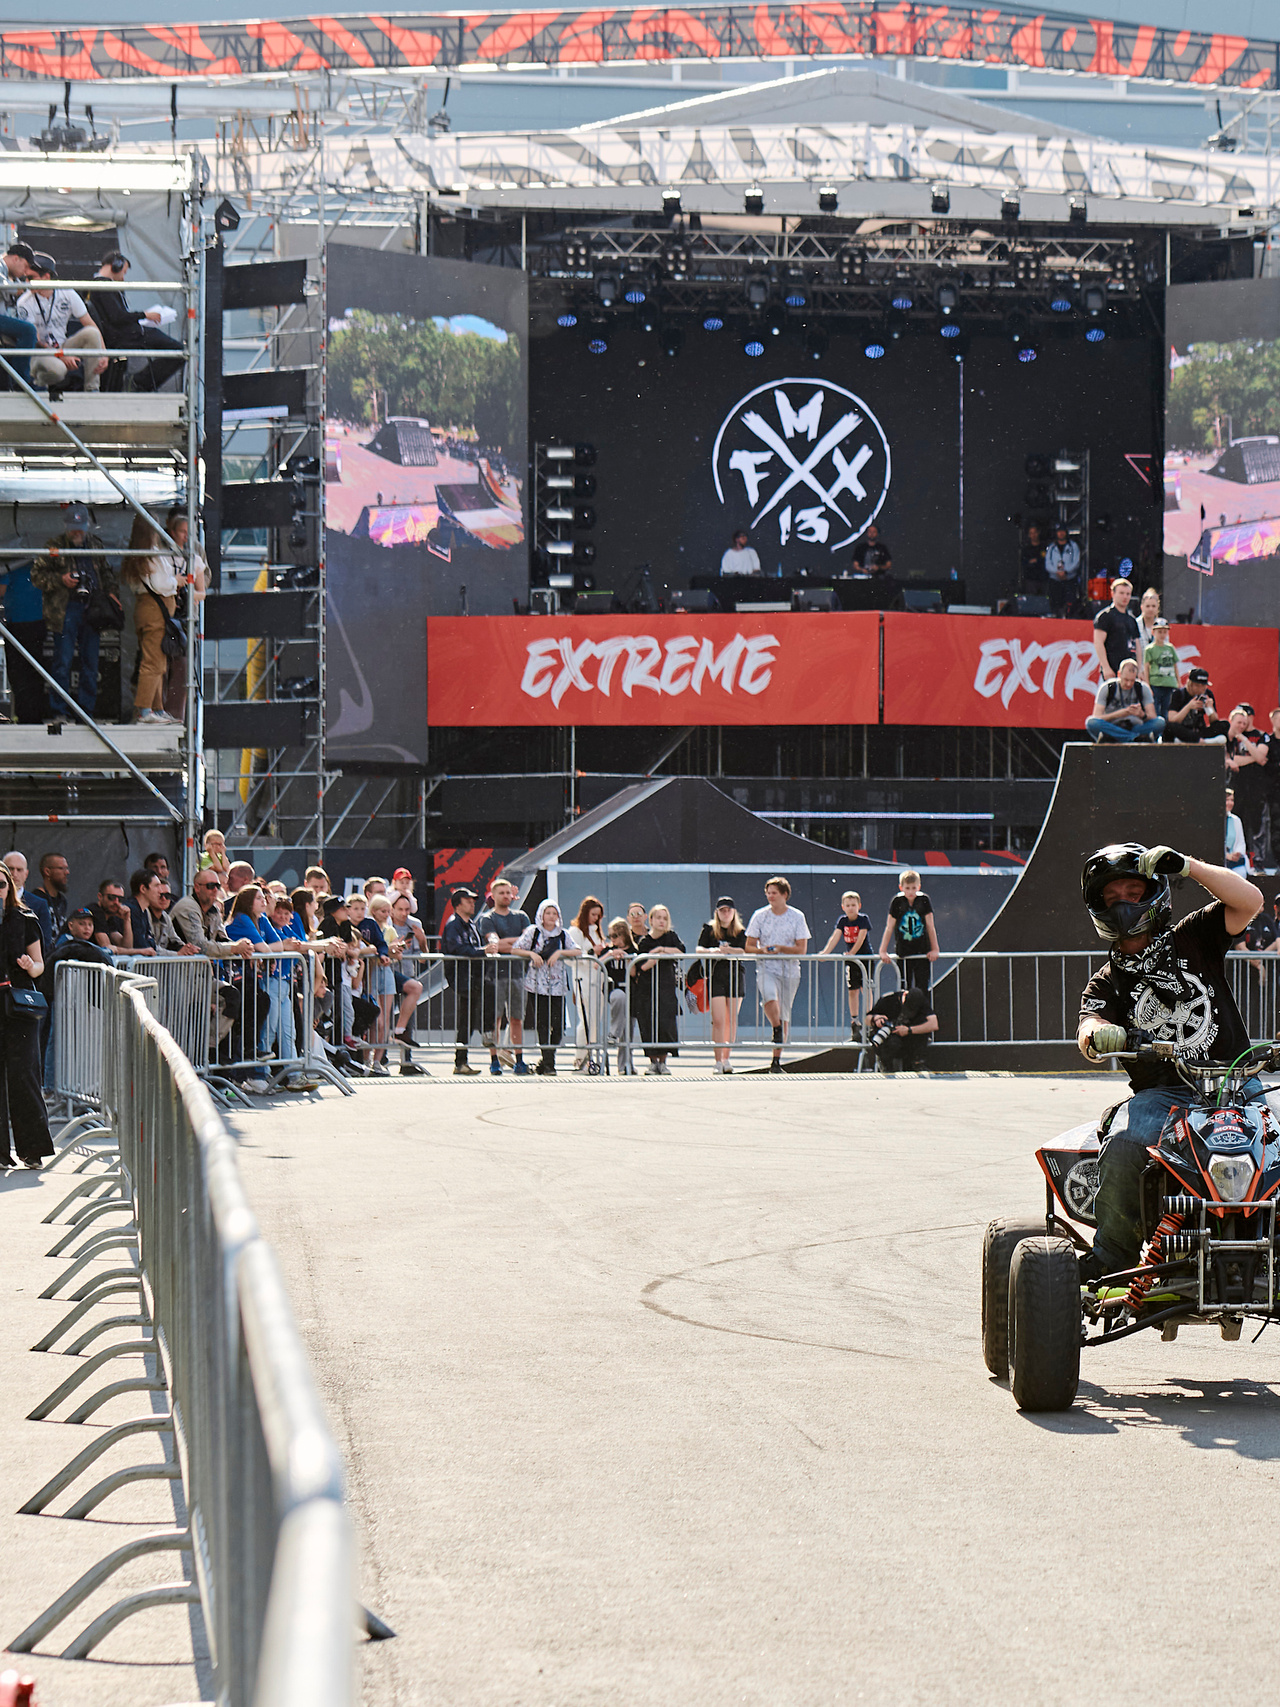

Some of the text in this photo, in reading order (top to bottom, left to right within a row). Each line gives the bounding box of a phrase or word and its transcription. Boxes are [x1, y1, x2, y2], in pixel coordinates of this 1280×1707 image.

[778, 504, 830, 547] 13
[520, 632, 781, 711] EXTREME
[1214, 1125, 1243, 1133] MOTUL
